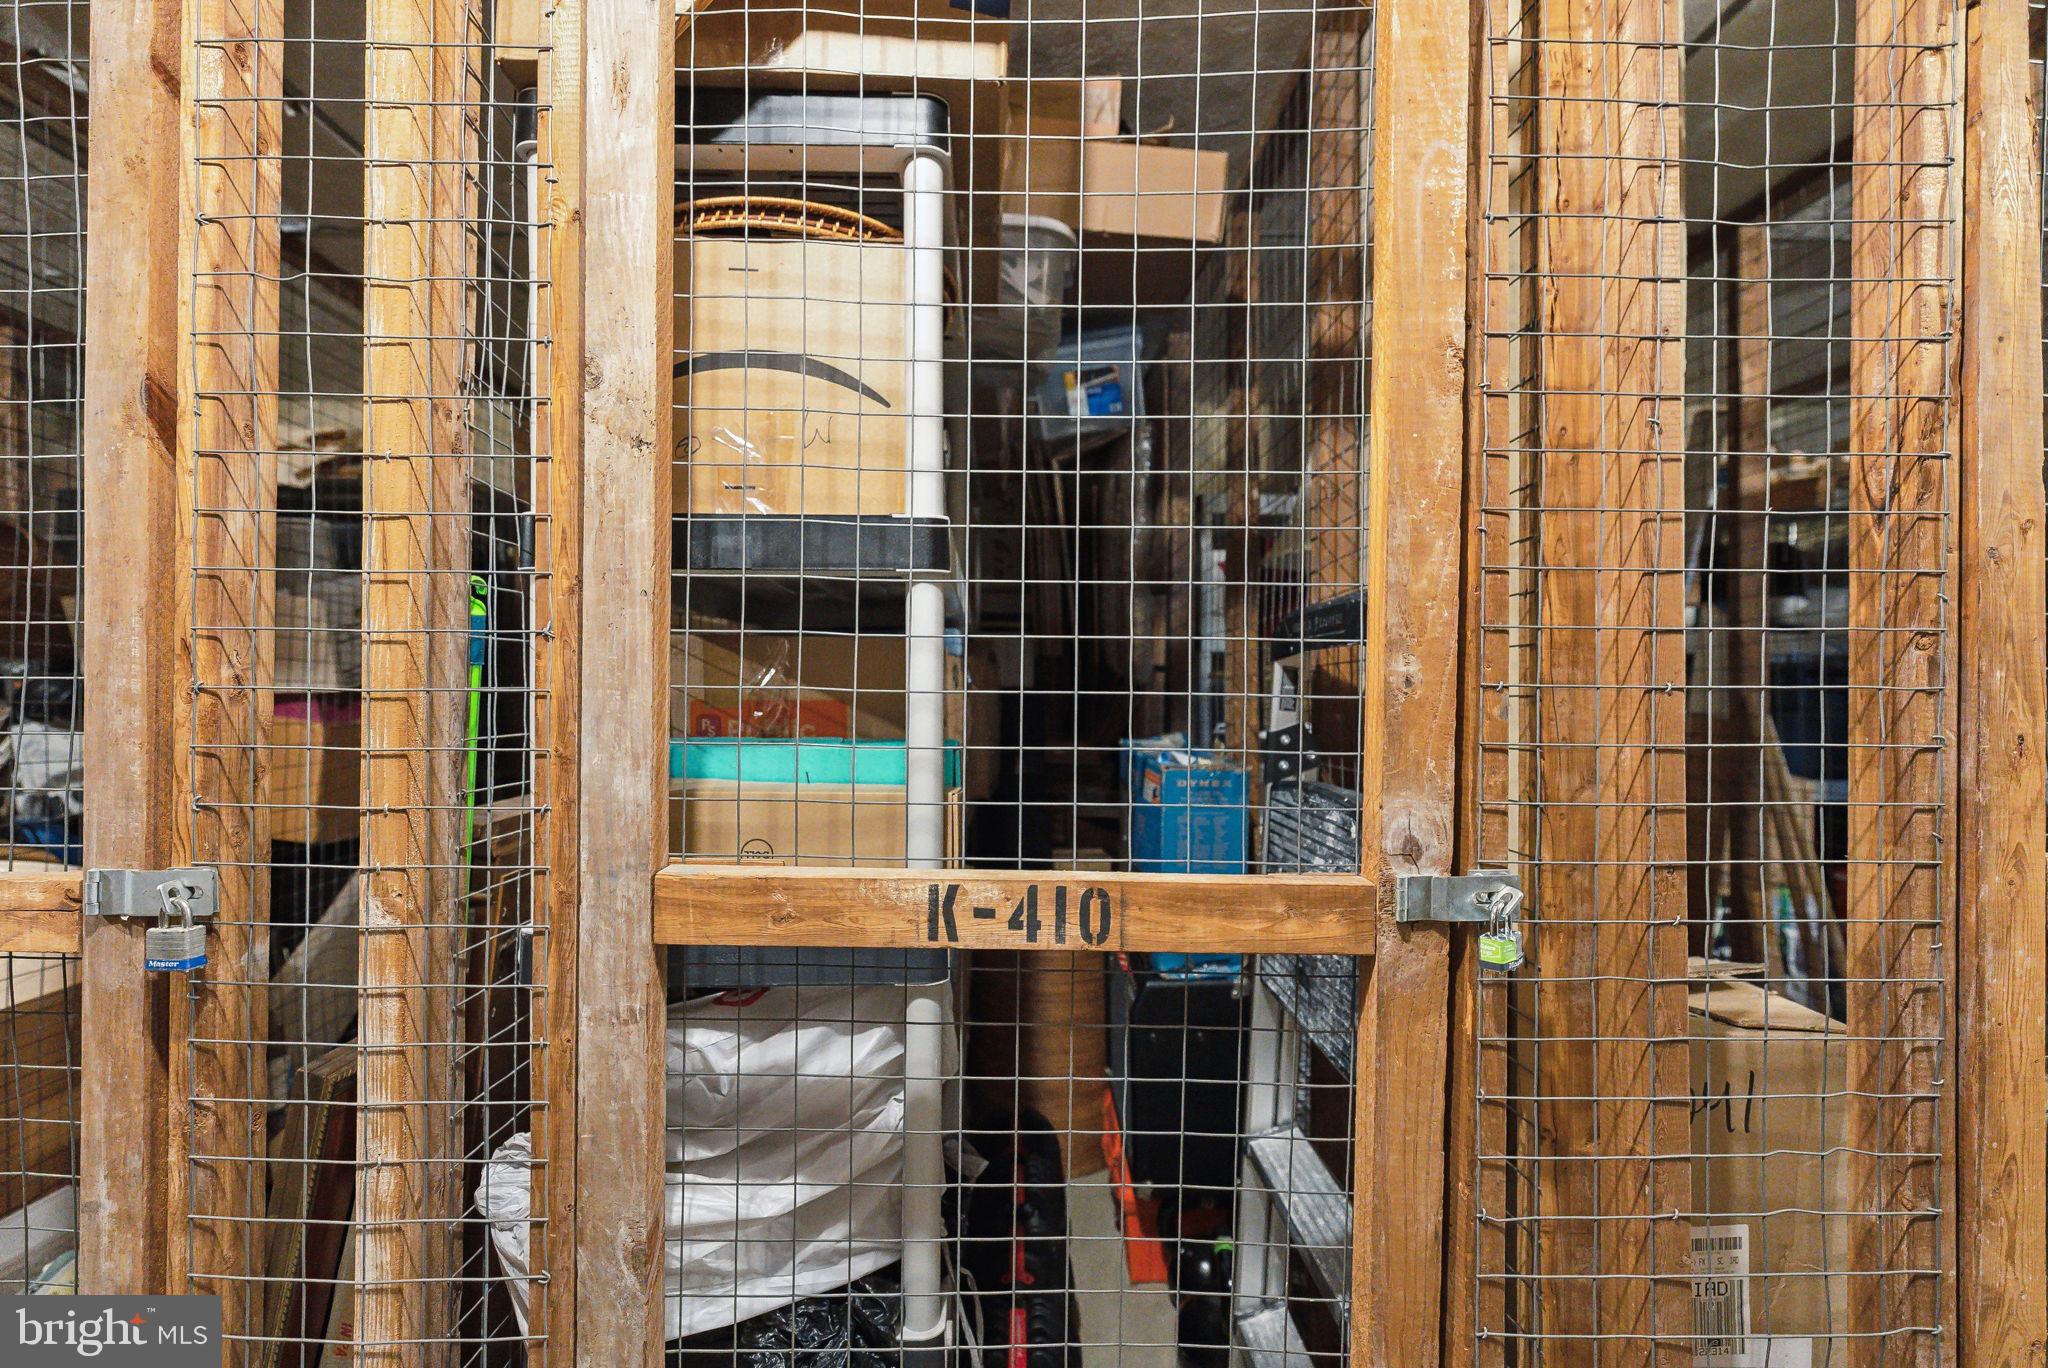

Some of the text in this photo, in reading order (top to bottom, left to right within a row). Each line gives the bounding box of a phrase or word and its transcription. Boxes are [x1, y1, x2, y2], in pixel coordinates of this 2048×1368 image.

[927, 884, 1112, 946] K-410
[148, 960, 179, 968] Master
[1694, 1281, 1728, 1298] IAD
